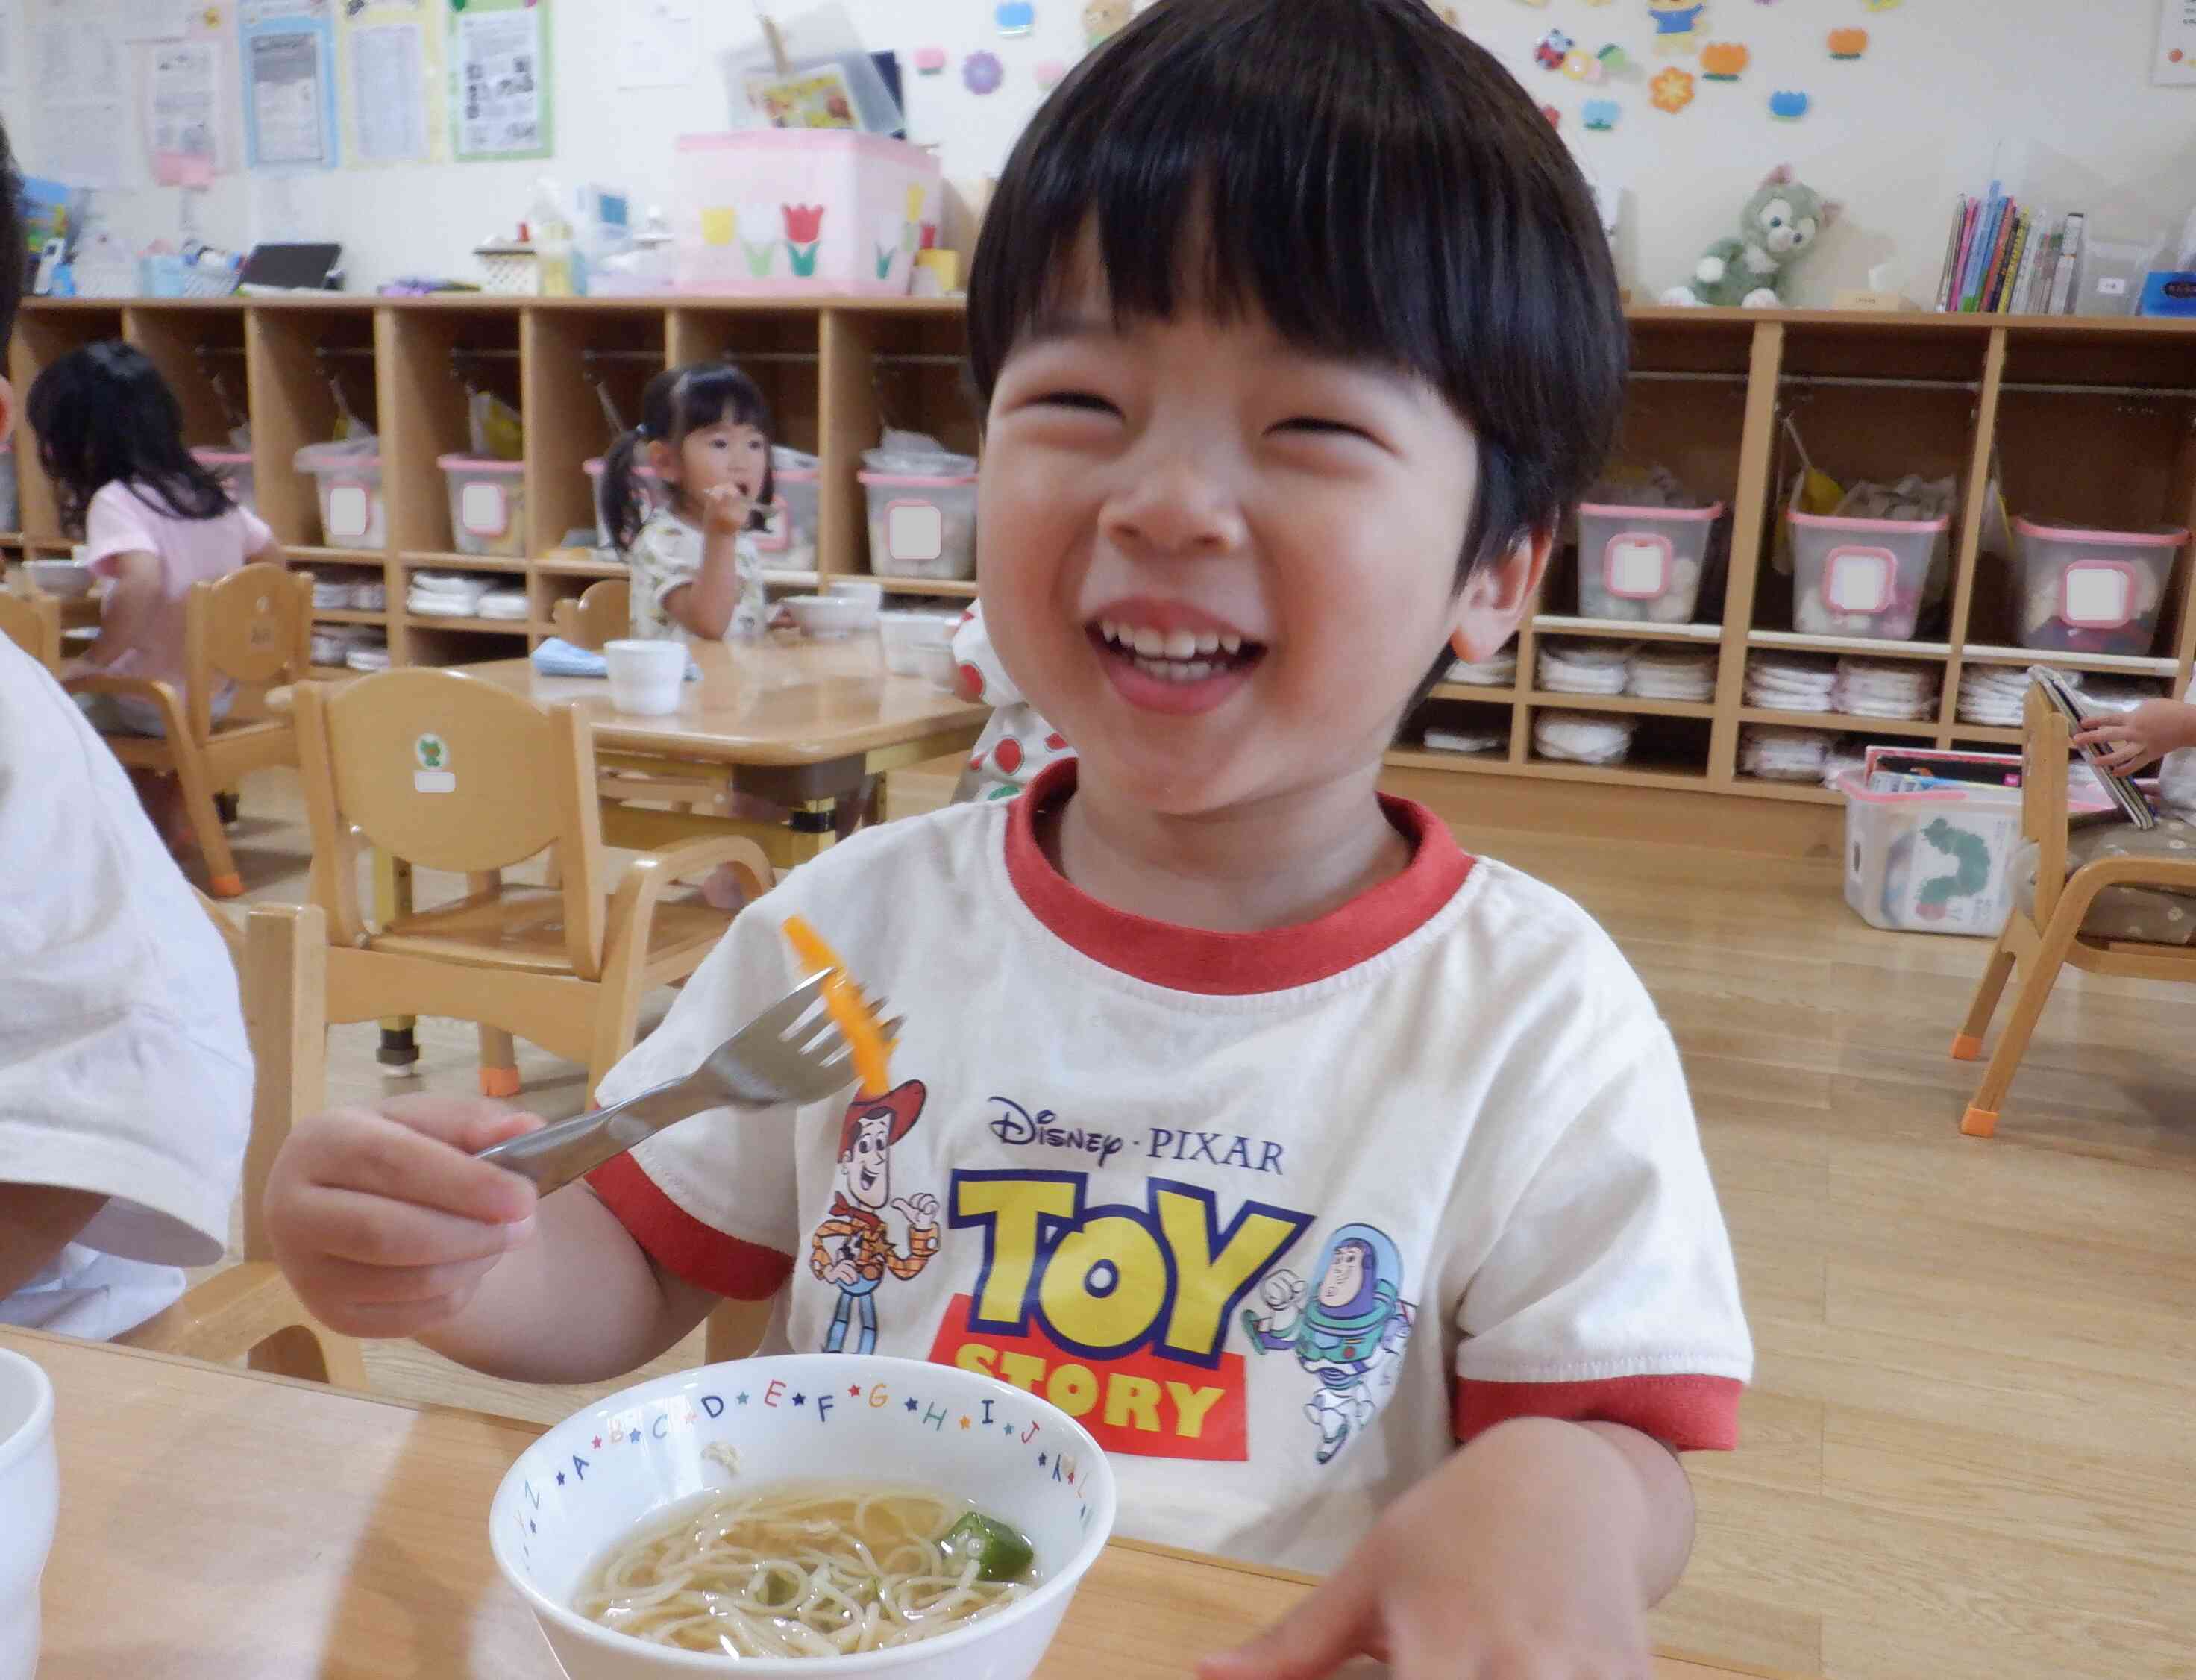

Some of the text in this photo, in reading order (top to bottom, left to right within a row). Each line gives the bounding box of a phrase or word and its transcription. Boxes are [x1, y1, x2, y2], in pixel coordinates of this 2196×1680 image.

[1146, 1127, 1284, 1175] PIXAR
[949, 1168, 1317, 1371] TOY
[572, 1455, 589, 1480] A
[652, 1414, 668, 1439] C
[701, 1395, 724, 1418] D
[764, 1379, 787, 1408] E
[818, 1395, 834, 1423] F
[868, 1383, 888, 1408] G
[922, 1401, 948, 1432] H
[981, 1400, 994, 1424] I
[1020, 1420, 1040, 1444] J
[955, 1344, 1225, 1438] STORY
